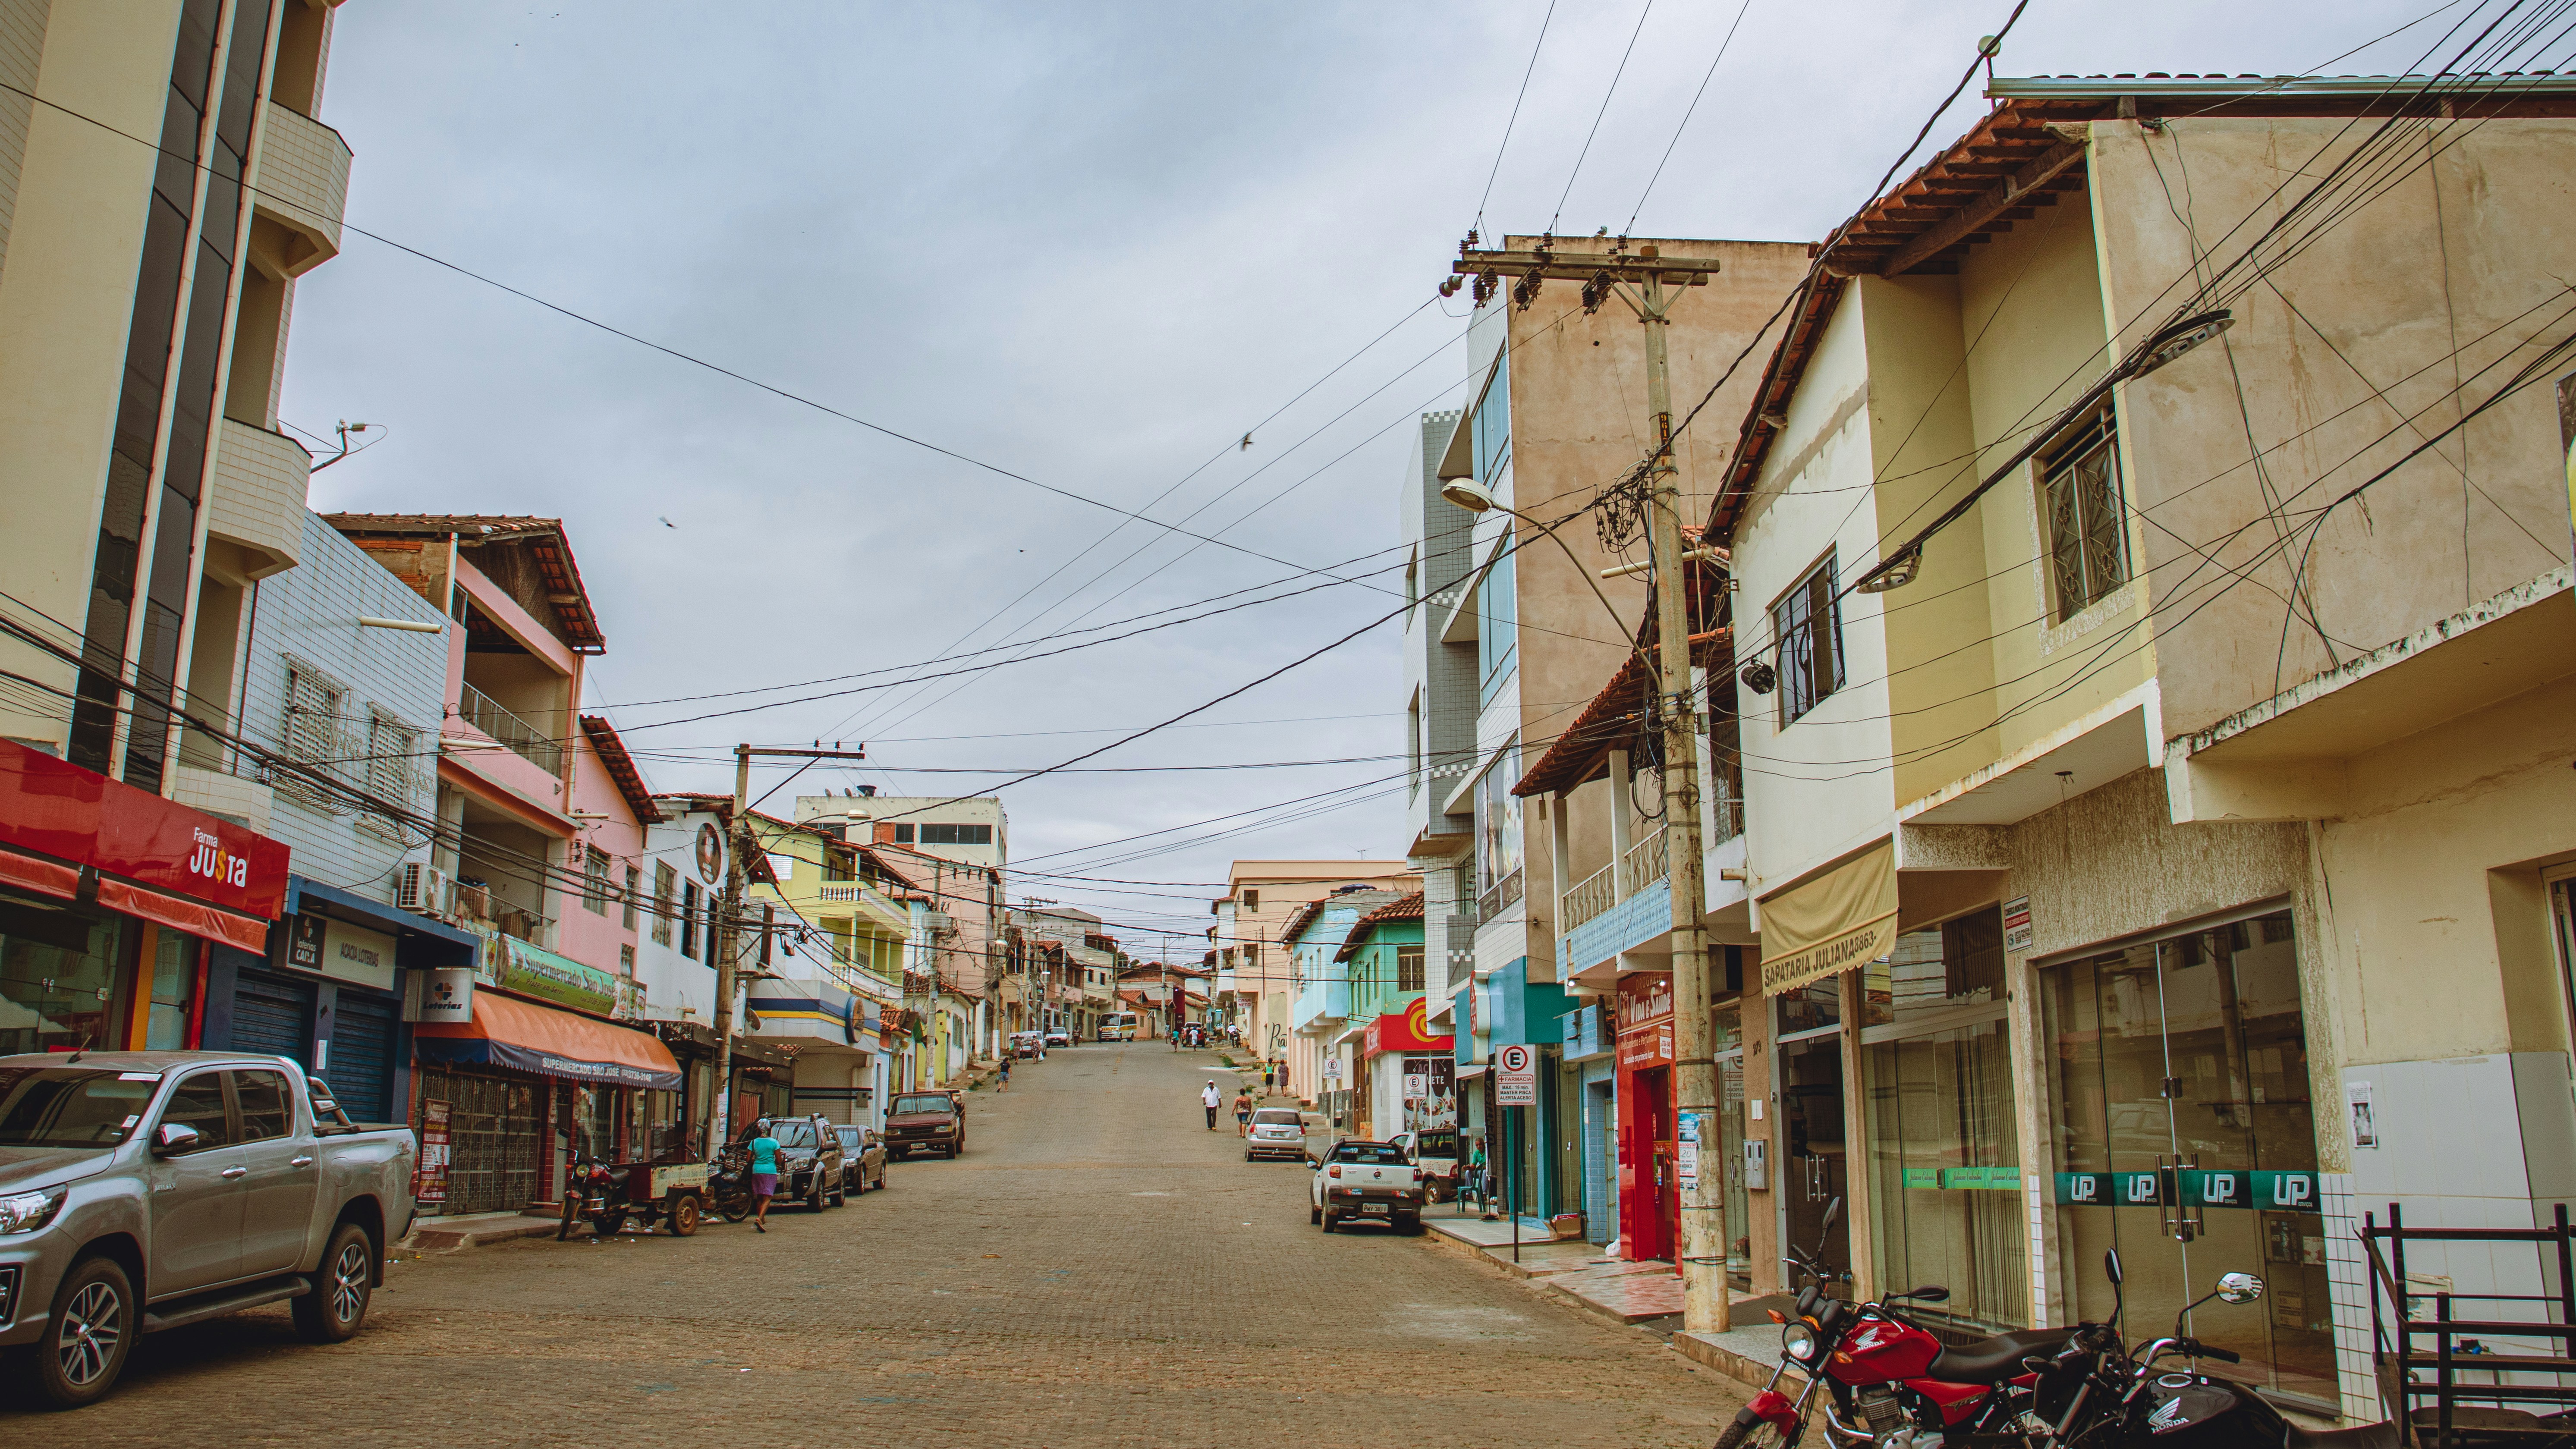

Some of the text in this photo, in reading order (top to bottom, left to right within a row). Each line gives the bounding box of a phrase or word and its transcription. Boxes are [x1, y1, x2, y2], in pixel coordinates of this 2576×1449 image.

[194, 827, 218, 847] Farma
[298, 937, 316, 951] loterias
[525, 953, 582, 988] Supermercado
[582, 970, 598, 993] São
[1765, 955, 1810, 987] SAPATARIA
[526, 978, 541, 989] Prazer
[1636, 972, 1662, 991] DROGARIA
[423, 1001, 462, 1009] Loterias
[1630, 994, 1645, 1023] VIDA
[1646, 1000, 1649, 1018] E
[543, 1057, 591, 1074] SUPERMERCADO
[593, 1064, 604, 1076] SÃO
[605, 1066, 619, 1077] JOSÉ
[1510, 1052, 1520, 1066] E
[1486, 1081, 1495, 1143] DENTISTA
[2071, 1176, 2095, 1201] UP
[2128, 1175, 2155, 1201] UP
[2204, 1174, 2235, 1203] UP
[2274, 1175, 2310, 1206] UP
[1857, 1340, 1885, 1351] HONDA
[1788, 1355, 1809, 1371] HONDA
[2151, 1417, 2189, 1434] HONDA
